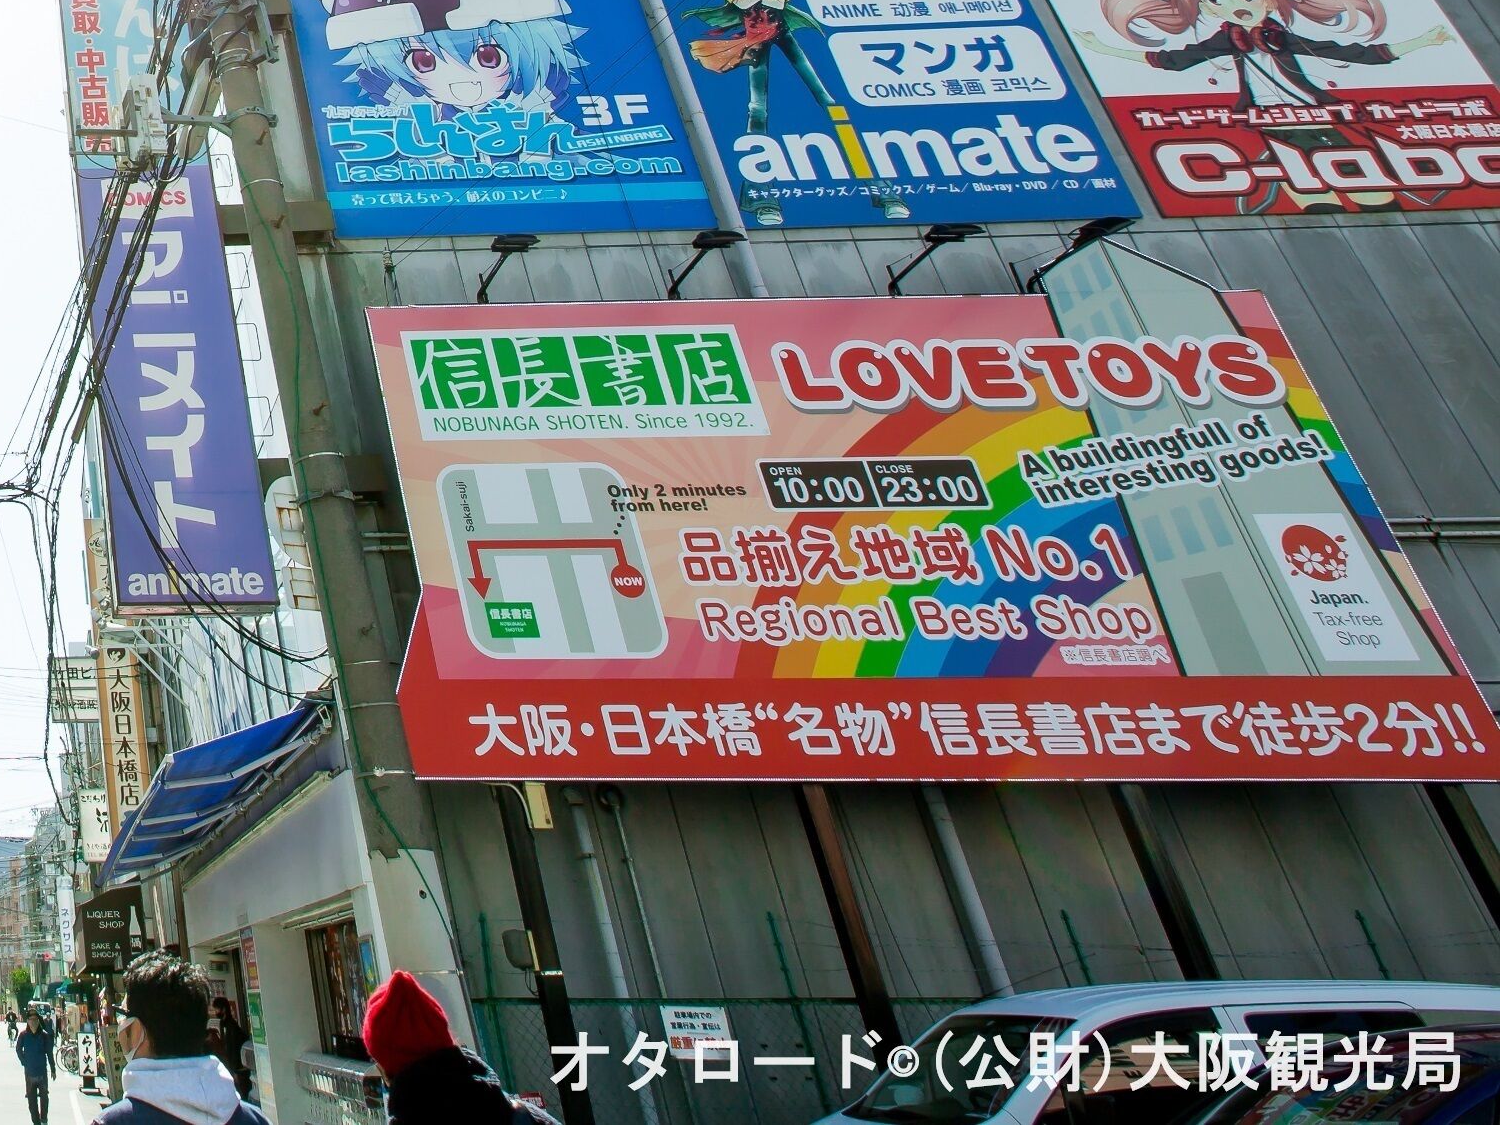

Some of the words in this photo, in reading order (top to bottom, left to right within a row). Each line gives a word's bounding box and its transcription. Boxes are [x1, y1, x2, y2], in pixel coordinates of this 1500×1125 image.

[821, 3, 883, 20] ANIME
[892, 1, 930, 18] 动漫
[940, 0, 1015, 16] 애니메이션
[860, 35, 1012, 74] マンガ
[862, 80, 937, 99] COMICS
[945, 78, 987, 97] 漫画
[991, 77, 1053, 95] 코믹스
[328, 100, 578, 163] らしんばん
[577, 93, 652, 127] 3F
[1135, 103, 1355, 128] カードゲームショップ
[1366, 98, 1492, 121] カードラボ
[567, 129, 667, 151] LASHINBANG
[732, 104, 1099, 184] animate
[335, 153, 684, 186] lashinbang.com
[411, 332, 752, 410] 信長書店
[120, 229, 217, 550] アニメイト
[432, 414, 541, 433] NOBUNAGA
[546, 413, 629, 431] SHOTEN.
[636, 412, 688, 430] Since
[693, 411, 755, 429] 1992.
[1021, 451, 1045, 480] A
[1052, 420, 1234, 478] buildingfull
[1237, 414, 1273, 442] of
[769, 466, 803, 476] OPEN
[875, 464, 914, 475] CLOSE
[1035, 454, 1213, 505] interesting
[1218, 433, 1330, 481] goods!
[606, 483, 650, 501] Only
[655, 483, 668, 498] 2
[672, 483, 748, 498] minutes
[610, 498, 653, 512] from
[656, 496, 710, 512] here!
[774, 475, 866, 505] 10:00
[881, 475, 980, 504] 23:00
[454, 479, 476, 534] Sakai-suji
[679, 526, 977, 586] 品揃え地域
[982, 523, 1134, 584] No.1
[127, 559, 265, 598] animate
[613, 575, 646, 589] NOW
[489, 608, 533, 620] 信長書店
[1309, 590, 1370, 608] Japan.
[698, 597, 905, 646] Regional
[917, 598, 1029, 641] Best
[1031, 595, 1159, 644] Shop
[1313, 611, 1384, 627] Tax-free
[1335, 631, 1381, 650] Shop
[110, 667, 140, 808] 大阪日本橋店
[86, 910, 121, 919] LIQUER
[99, 920, 125, 929] SHOP
[91, 942, 111, 950] SAKE
[81, 1035, 95, 1075] らーめん
